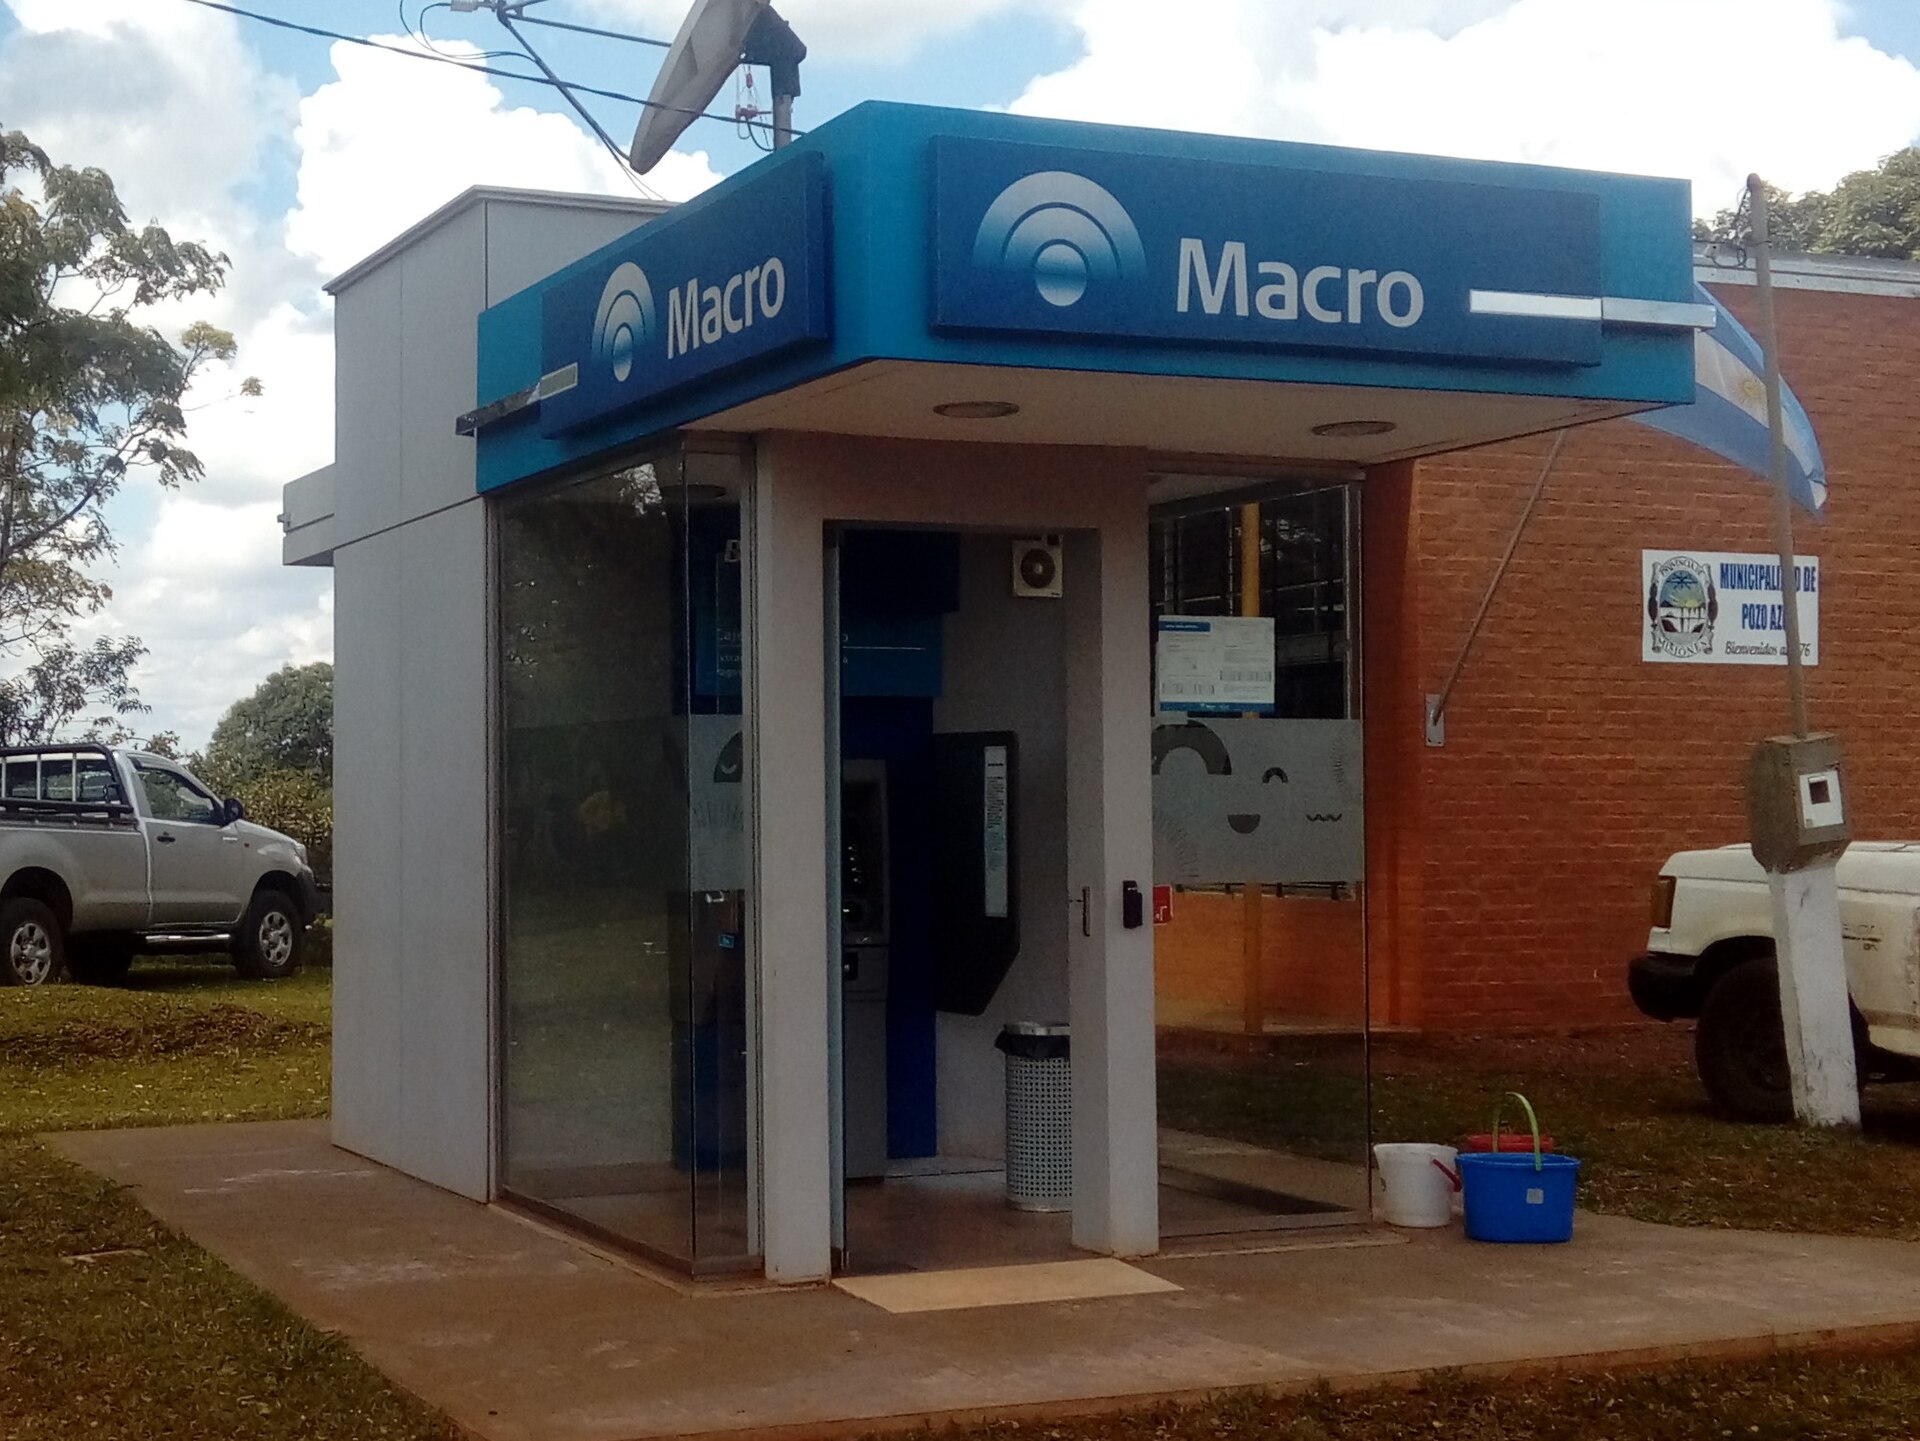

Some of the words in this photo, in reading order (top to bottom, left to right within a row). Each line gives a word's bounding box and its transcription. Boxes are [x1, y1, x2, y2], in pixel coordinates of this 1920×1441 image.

[1176, 237, 1425, 328] Macro
[667, 257, 786, 359] Macro
[1720, 563, 1801, 592] MUNICIPALID
[1803, 566, 1816, 592] DE
[1742, 603, 1768, 630] POZO
[1770, 605, 1787, 630] AZ
[1725, 641, 1777, 656] Bienvenidos
